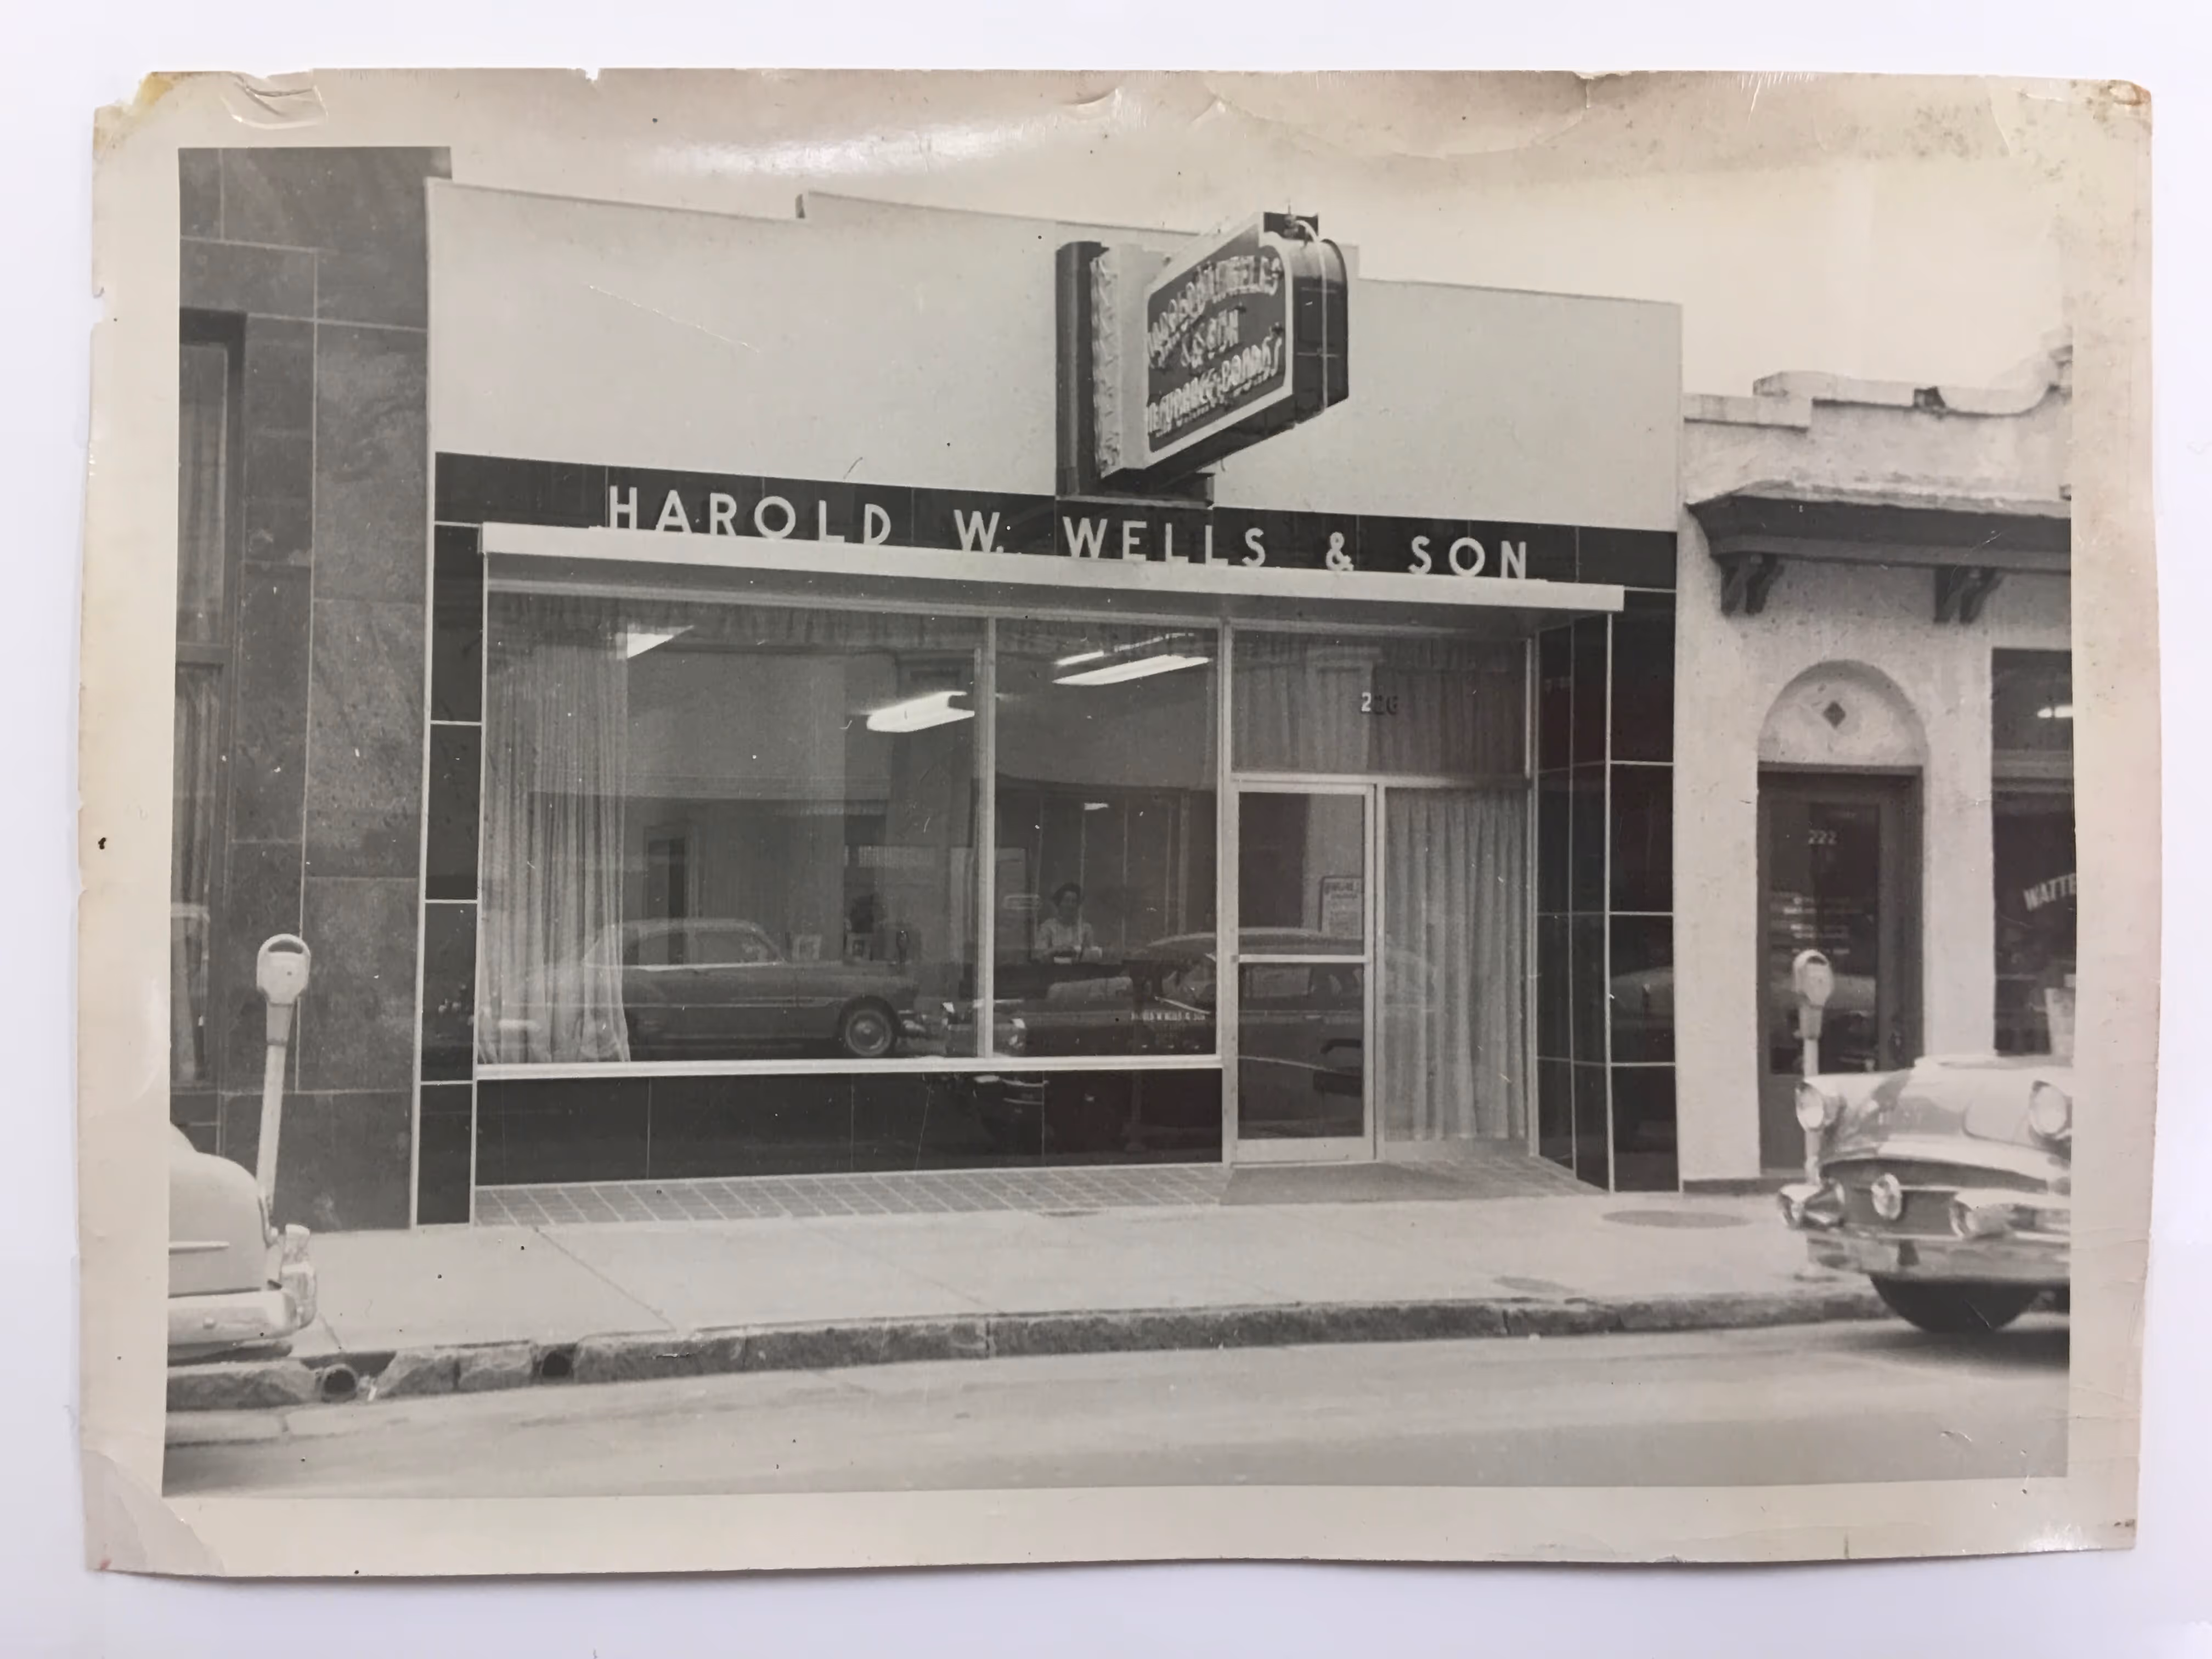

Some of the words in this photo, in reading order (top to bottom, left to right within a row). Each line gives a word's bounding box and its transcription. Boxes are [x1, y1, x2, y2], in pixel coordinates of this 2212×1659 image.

[609, 485, 891, 545] HAROLD
[953, 509, 1004, 553] W.
[1063, 516, 1266, 568] WELLS
[1325, 531, 1355, 572] &
[1408, 535, 1527, 580] SON
